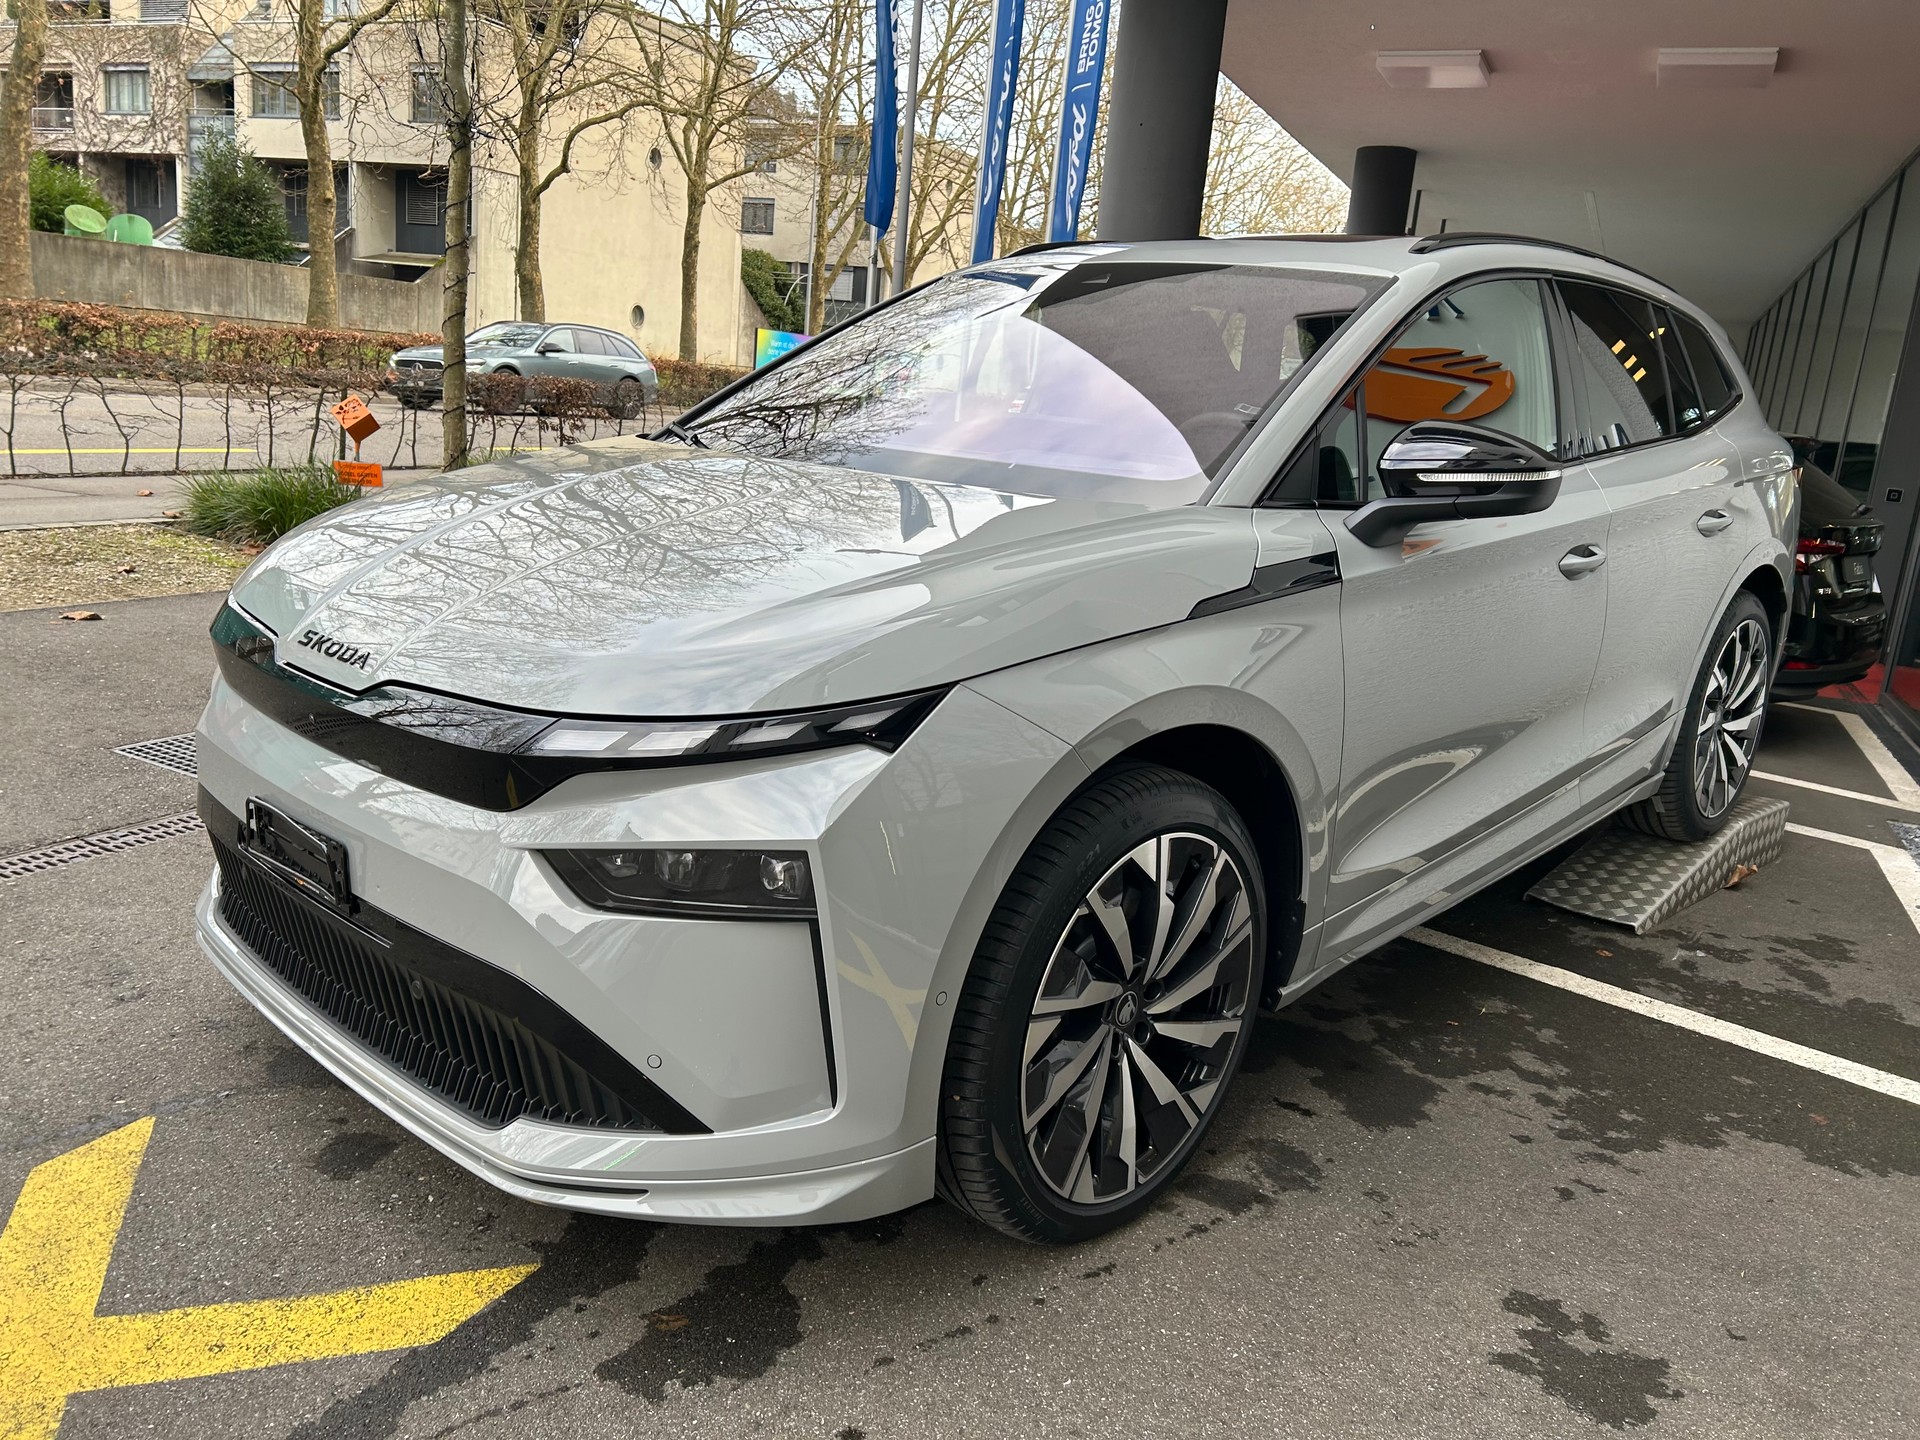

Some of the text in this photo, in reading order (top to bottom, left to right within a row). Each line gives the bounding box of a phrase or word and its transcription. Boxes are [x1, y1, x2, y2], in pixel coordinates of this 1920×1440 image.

[1085, 0, 1104, 72] TOMO
[1065, 5, 1095, 232] Ford BRING
